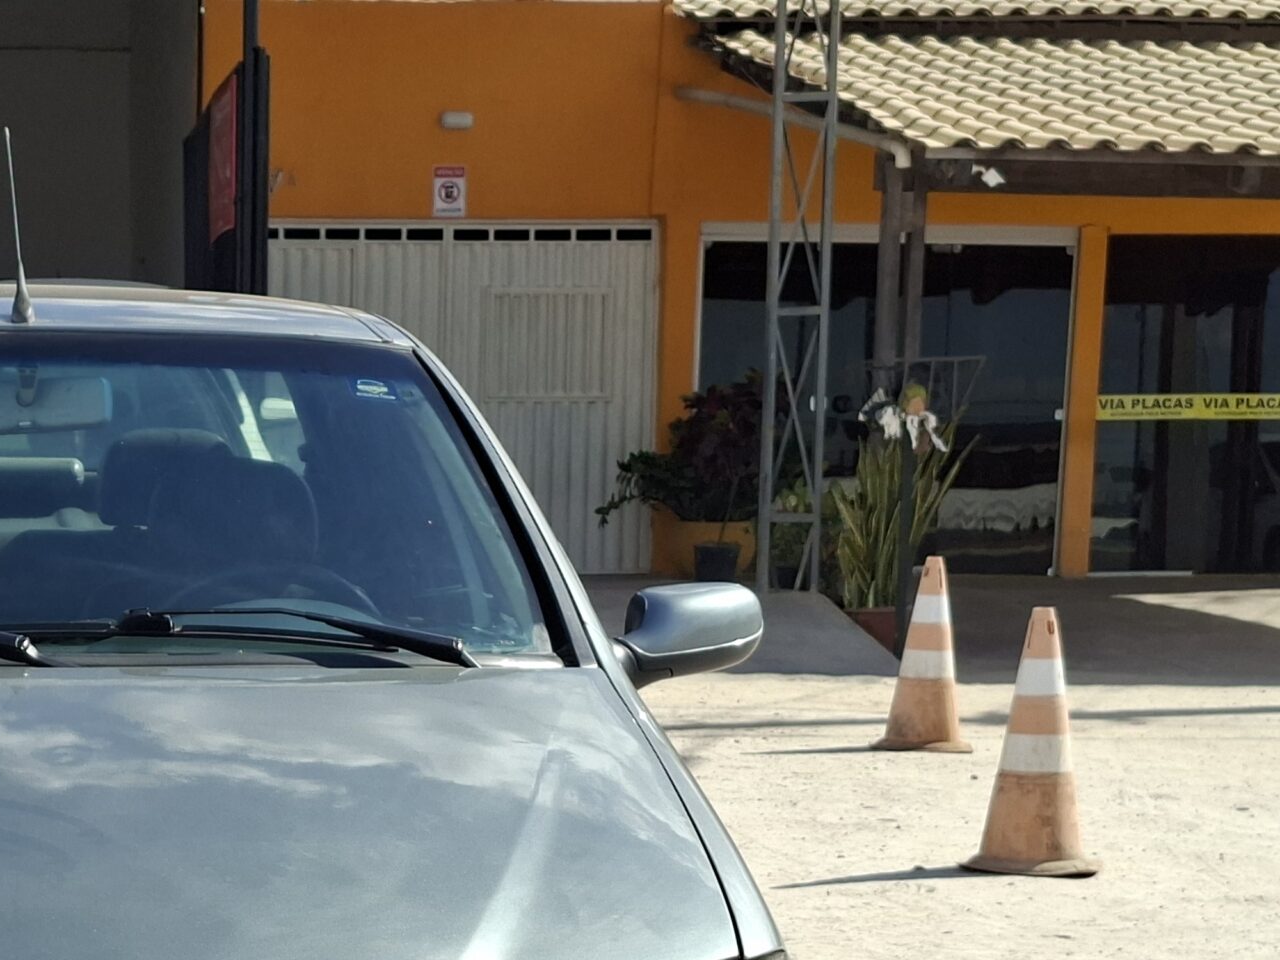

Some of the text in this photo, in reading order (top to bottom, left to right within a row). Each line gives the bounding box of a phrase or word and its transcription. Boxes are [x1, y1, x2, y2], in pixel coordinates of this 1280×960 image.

[1098, 397, 1280, 410] VIA PLACAS VIA PLAC
